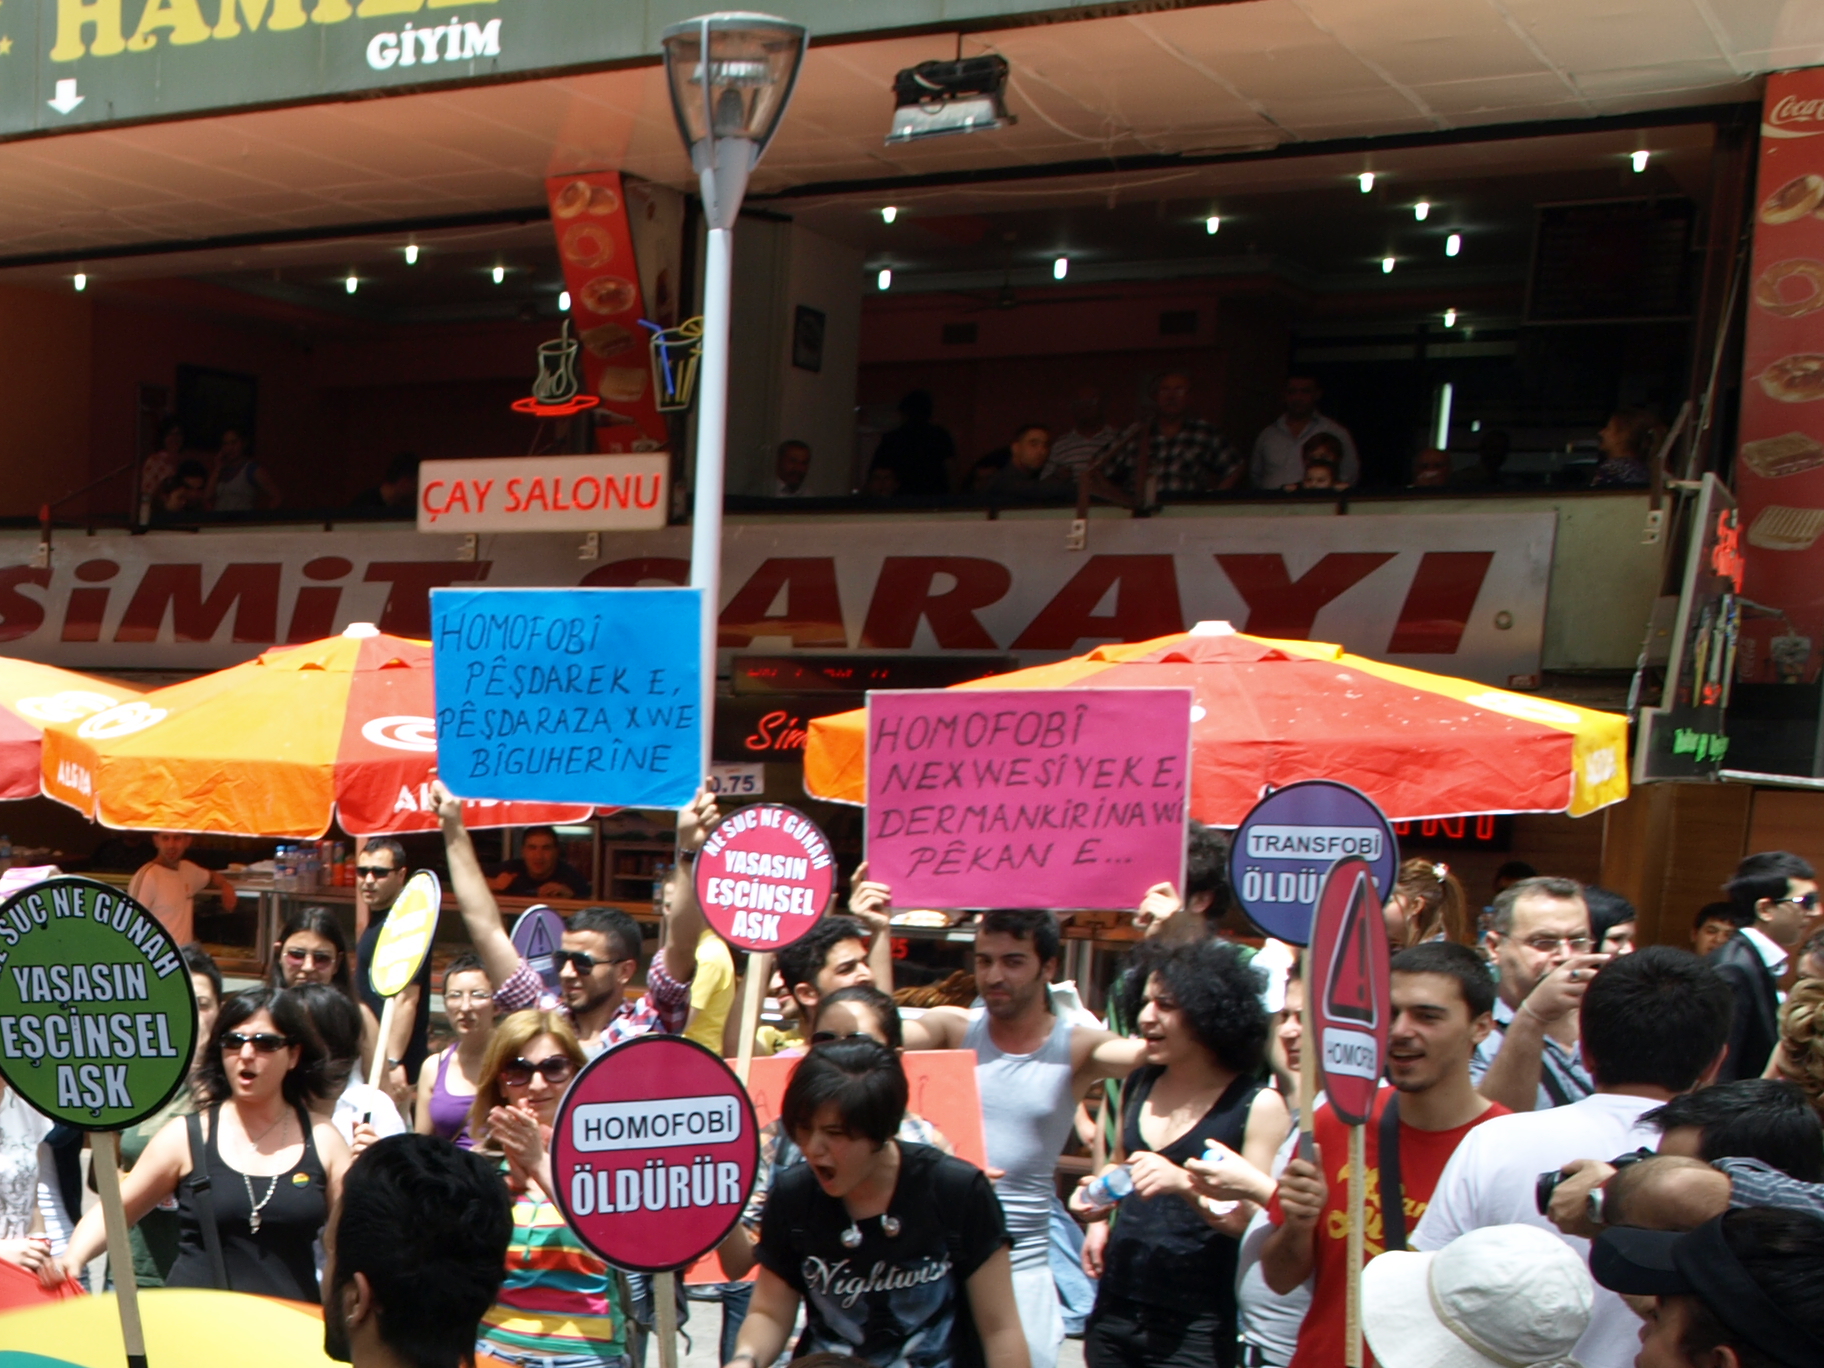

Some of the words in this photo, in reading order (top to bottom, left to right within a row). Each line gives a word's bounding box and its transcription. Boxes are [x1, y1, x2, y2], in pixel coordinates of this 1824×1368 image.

[366, 16, 502, 70] GİYİM
[422, 478, 495, 523] ÇAY
[504, 473, 662, 513] SALONU
[578, 551, 1496, 655] ARAYI
[464, 655, 631, 699] PÊŞDAREK
[702, 831, 726, 857] NE
[759, 808, 782, 827] NE
[1251, 833, 1382, 855] TRANSFOBİ
[906, 840, 1055, 878] PÊKAN
[50, 887, 87, 919] NE
[92, 892, 181, 980] GÜNAH
[730, 910, 782, 944] AŞK
[10, 961, 149, 1010] YAŞASIN
[56, 1063, 135, 1118] AŞK
[584, 1104, 735, 1142] HOMOFOBİ
[571, 1155, 741, 1216] ÖLDÜRÜR
